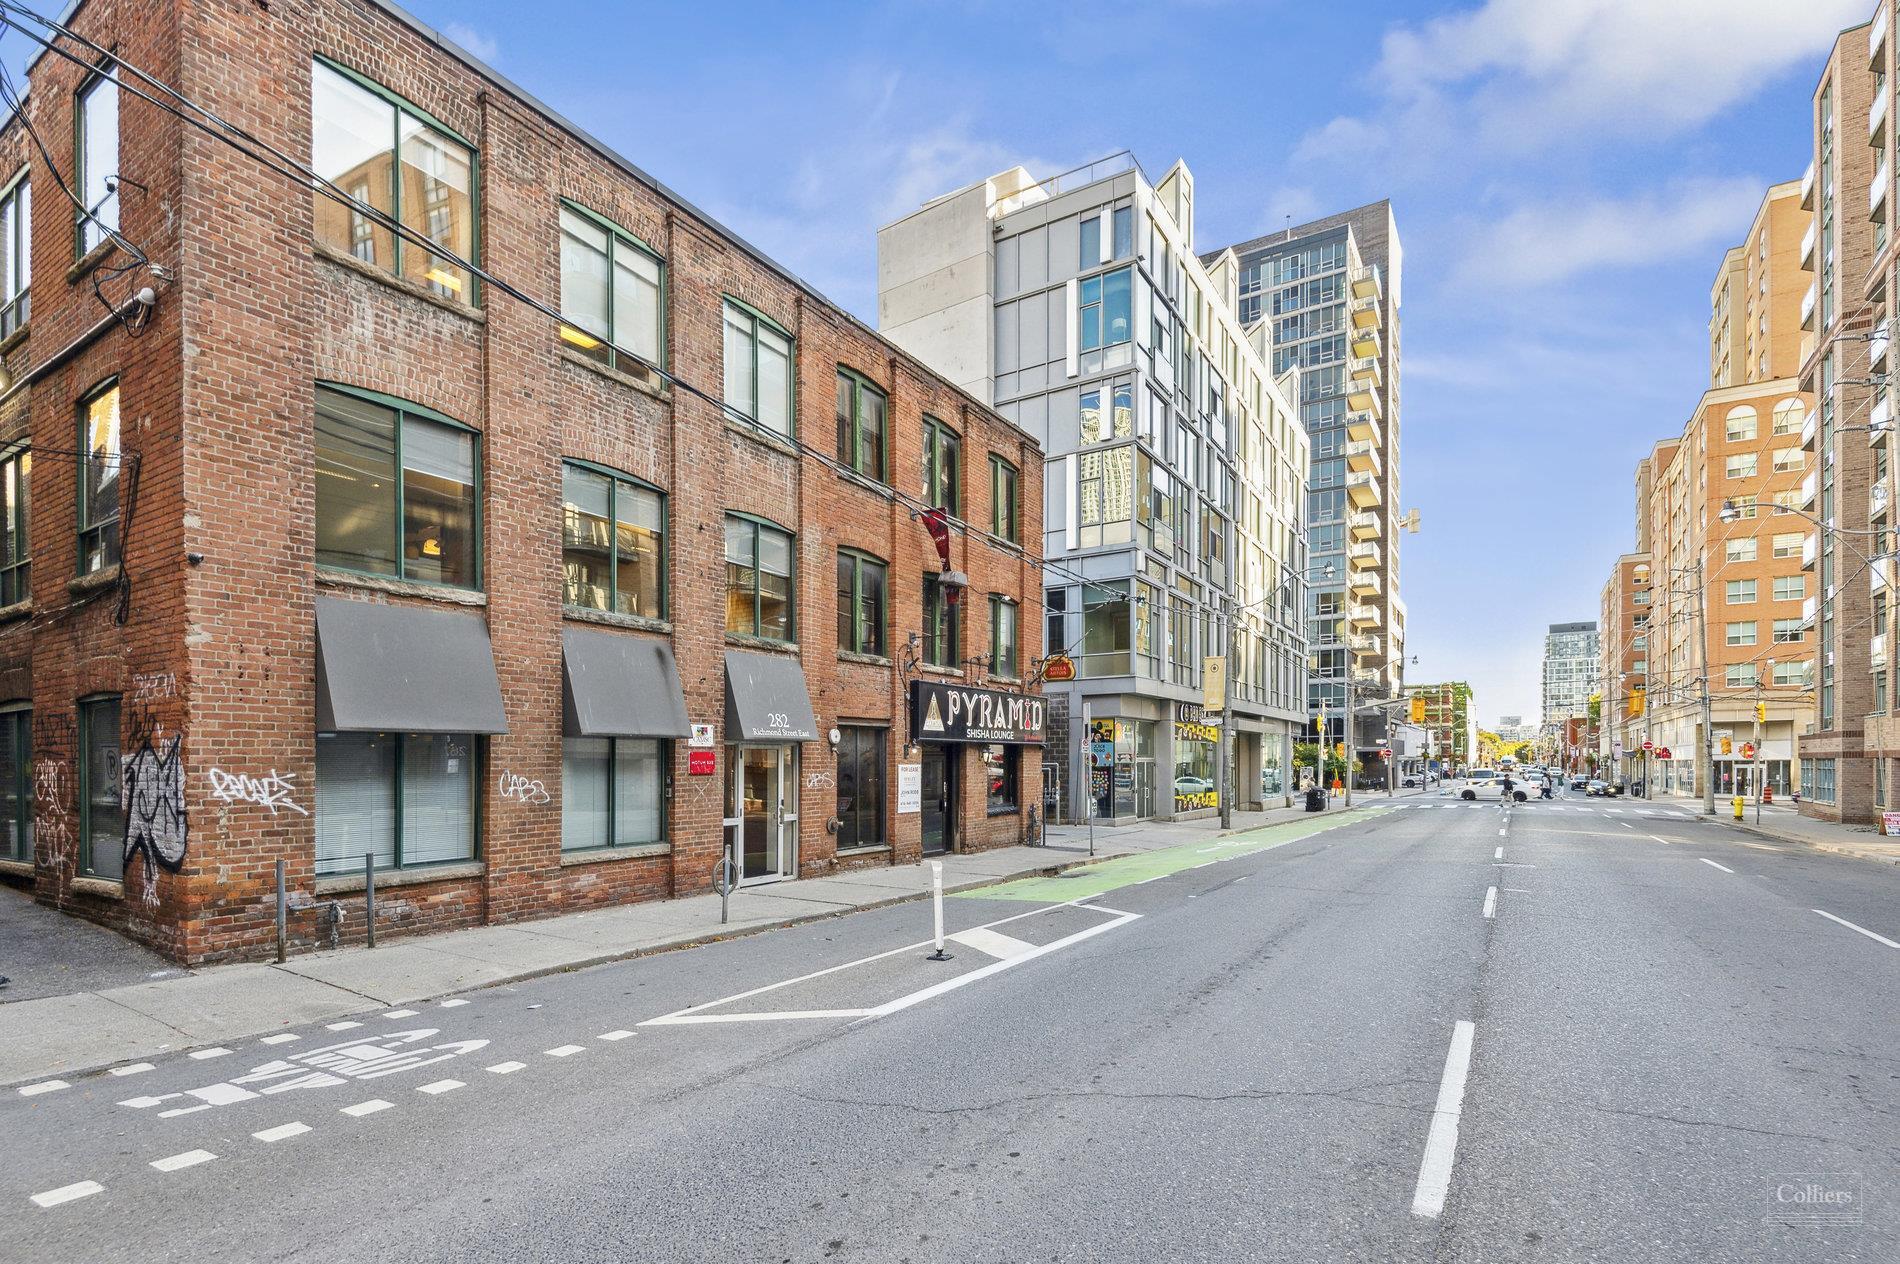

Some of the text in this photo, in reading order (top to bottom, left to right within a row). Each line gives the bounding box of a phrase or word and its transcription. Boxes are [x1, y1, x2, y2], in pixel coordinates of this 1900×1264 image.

[947, 690, 1043, 731] PYRAMID
[767, 712, 790, 728] 282
[752, 727, 810, 737] Richmond Street East
[966, 728, 990, 739] SHISHA
[990, 731, 1015, 740] LOUNGE
